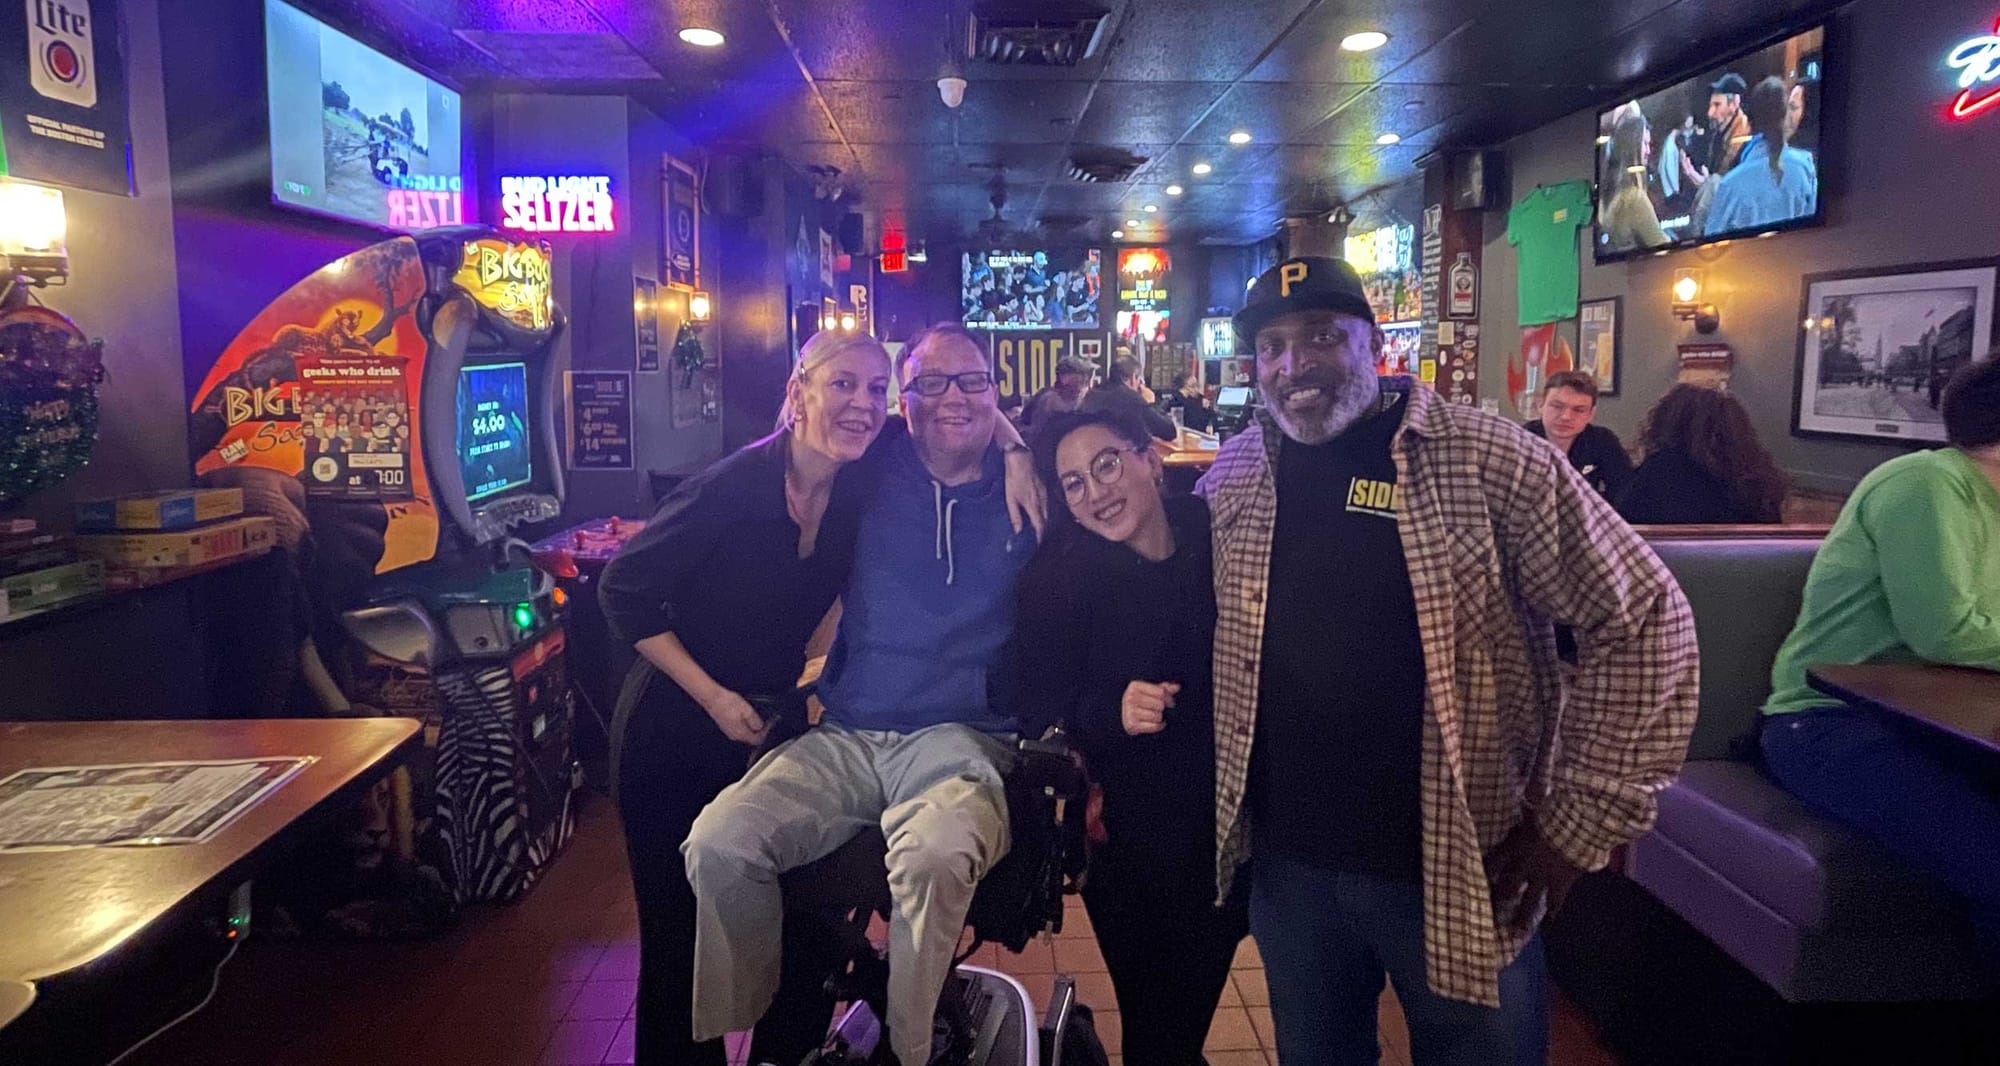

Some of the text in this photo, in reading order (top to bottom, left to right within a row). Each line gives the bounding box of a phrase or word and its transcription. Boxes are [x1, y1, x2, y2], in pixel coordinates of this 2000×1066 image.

[36, 0, 86, 37] Lite
[501, 176, 610, 195] BUD LIGHT
[502, 191, 615, 231] SELTZER
[481, 247, 523, 286] BIG
[1281, 262, 1307, 297] P
[303, 367, 401, 378] geeks who drink
[999, 339, 1063, 396] SIDE
[224, 386, 285, 427] BIG
[473, 414, 506, 435] $4.00
[349, 469, 404, 485] at 7:00
